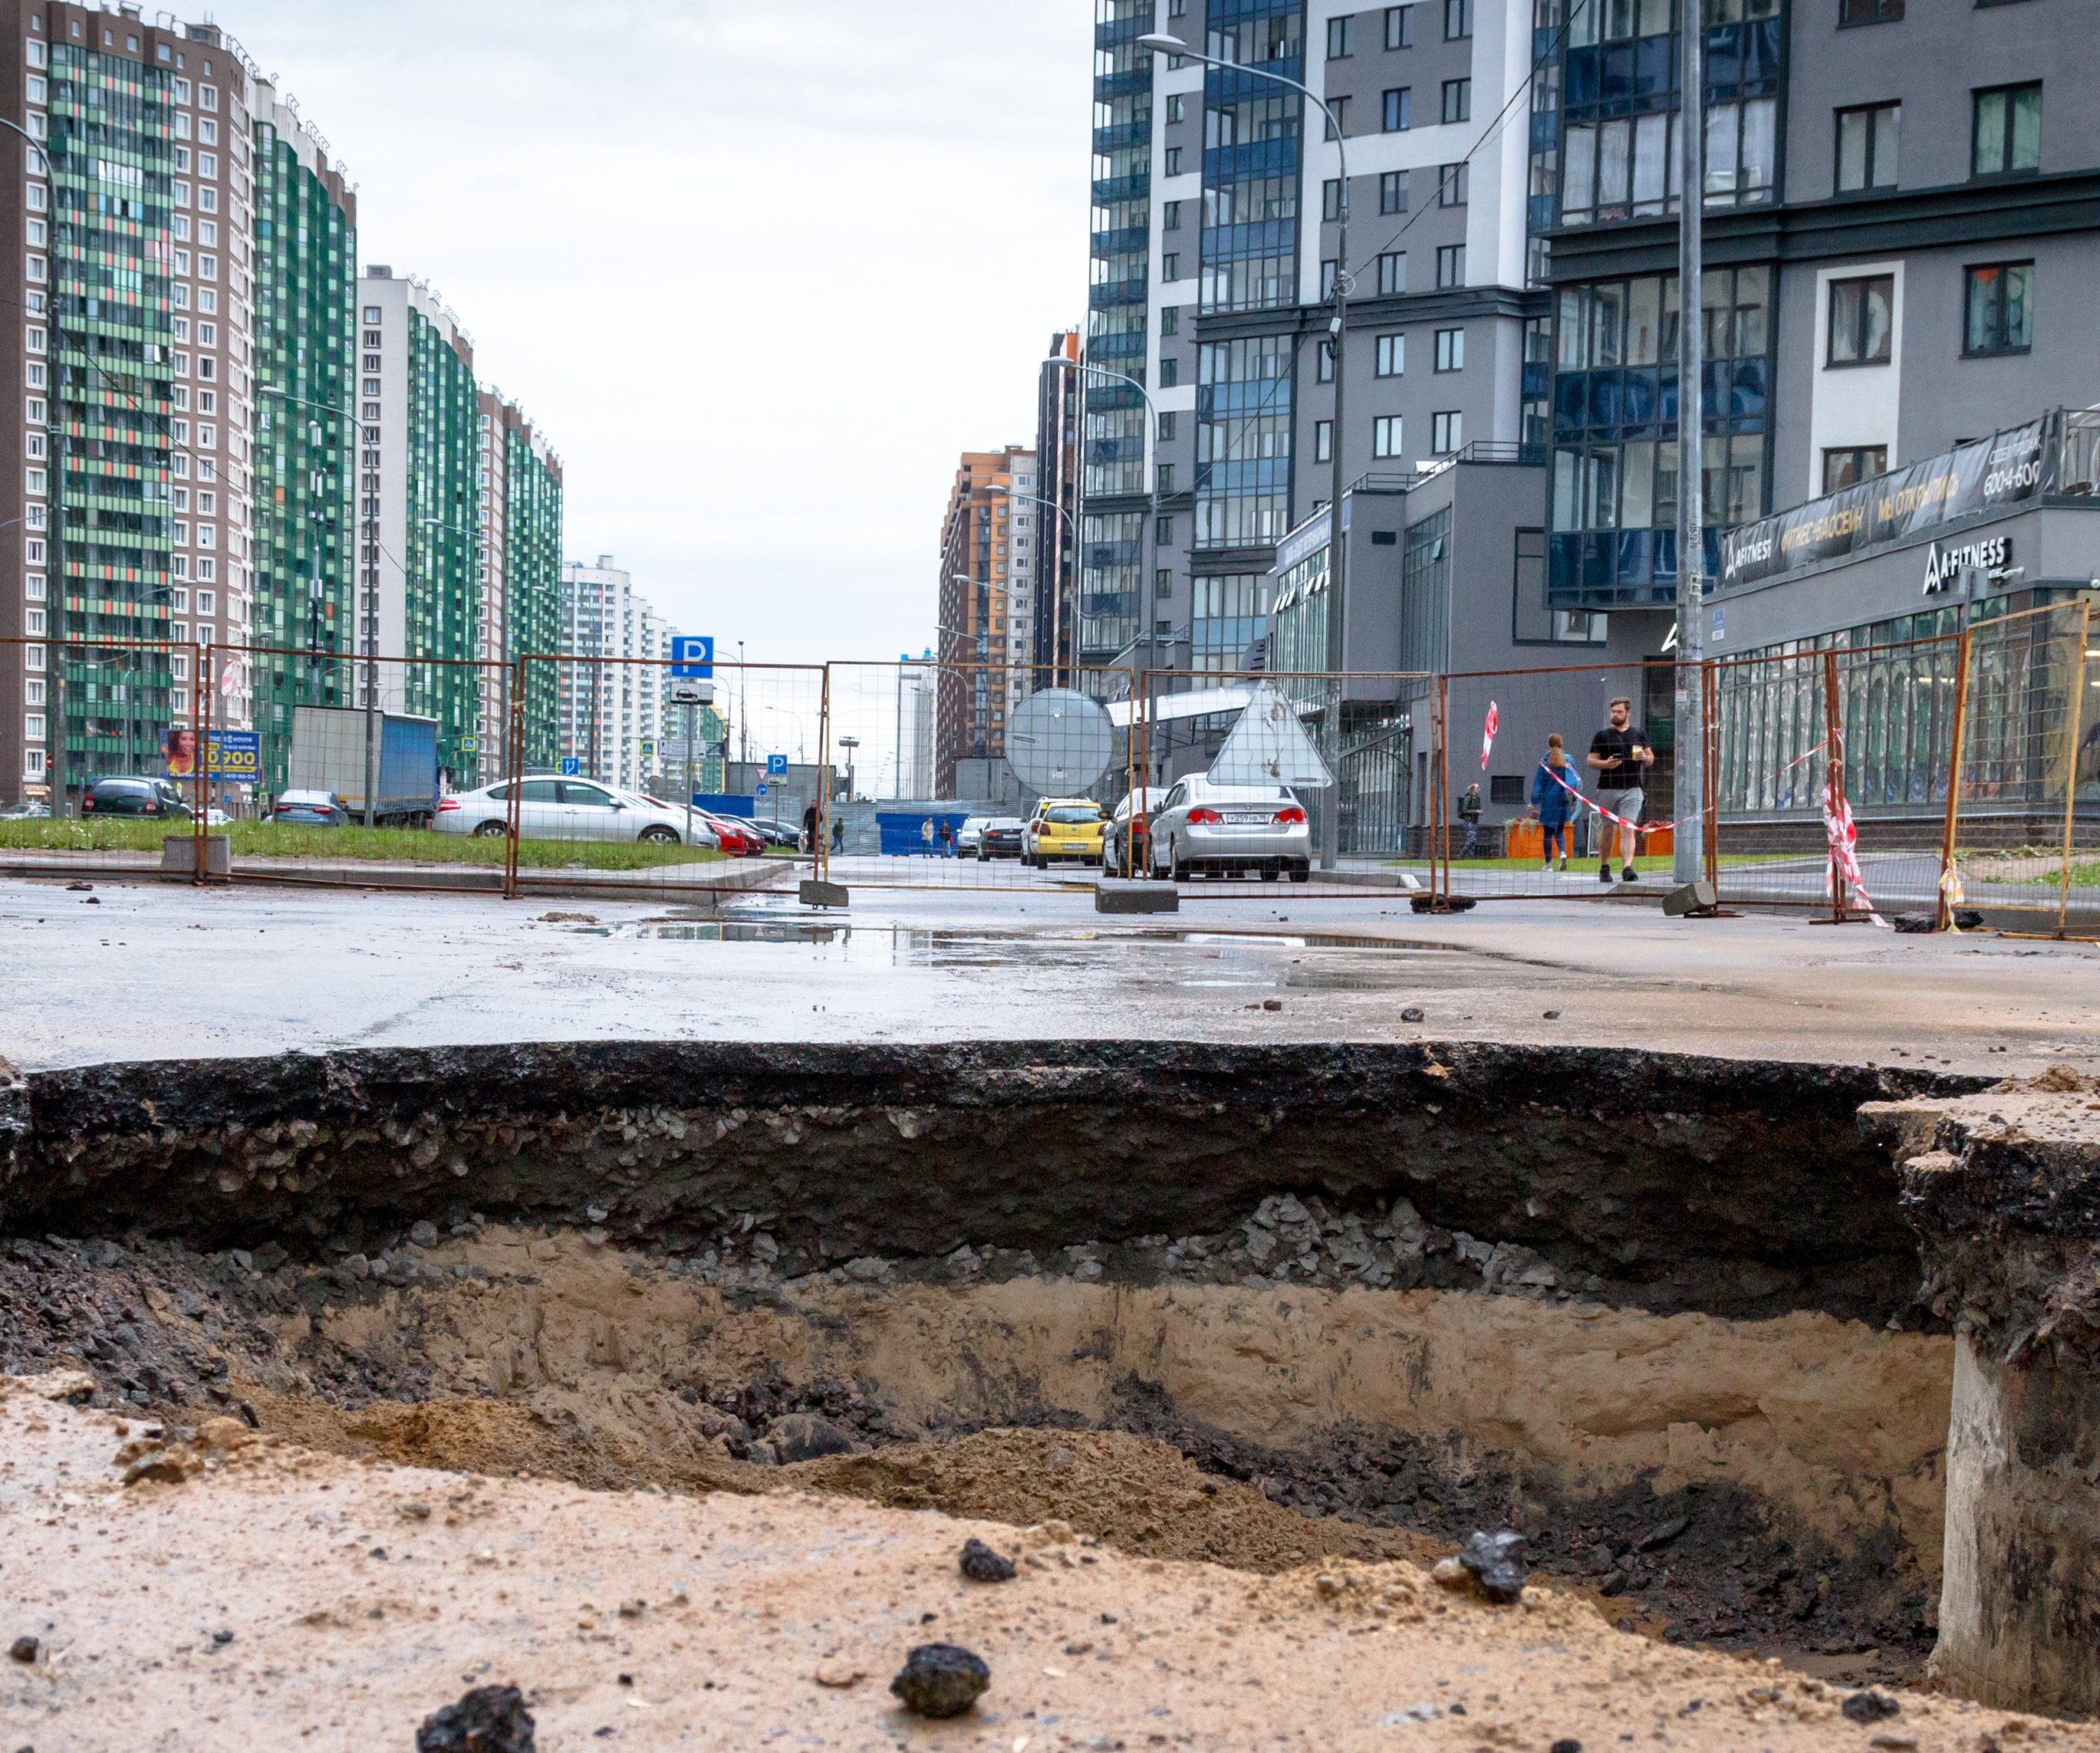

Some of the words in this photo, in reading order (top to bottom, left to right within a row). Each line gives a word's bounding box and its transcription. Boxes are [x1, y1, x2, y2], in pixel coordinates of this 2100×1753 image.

[1984, 460, 2041, 496] 600-4-600
[682, 640, 706, 673] P
[223, 751, 256, 765] 900
[772, 756, 784, 773] P
